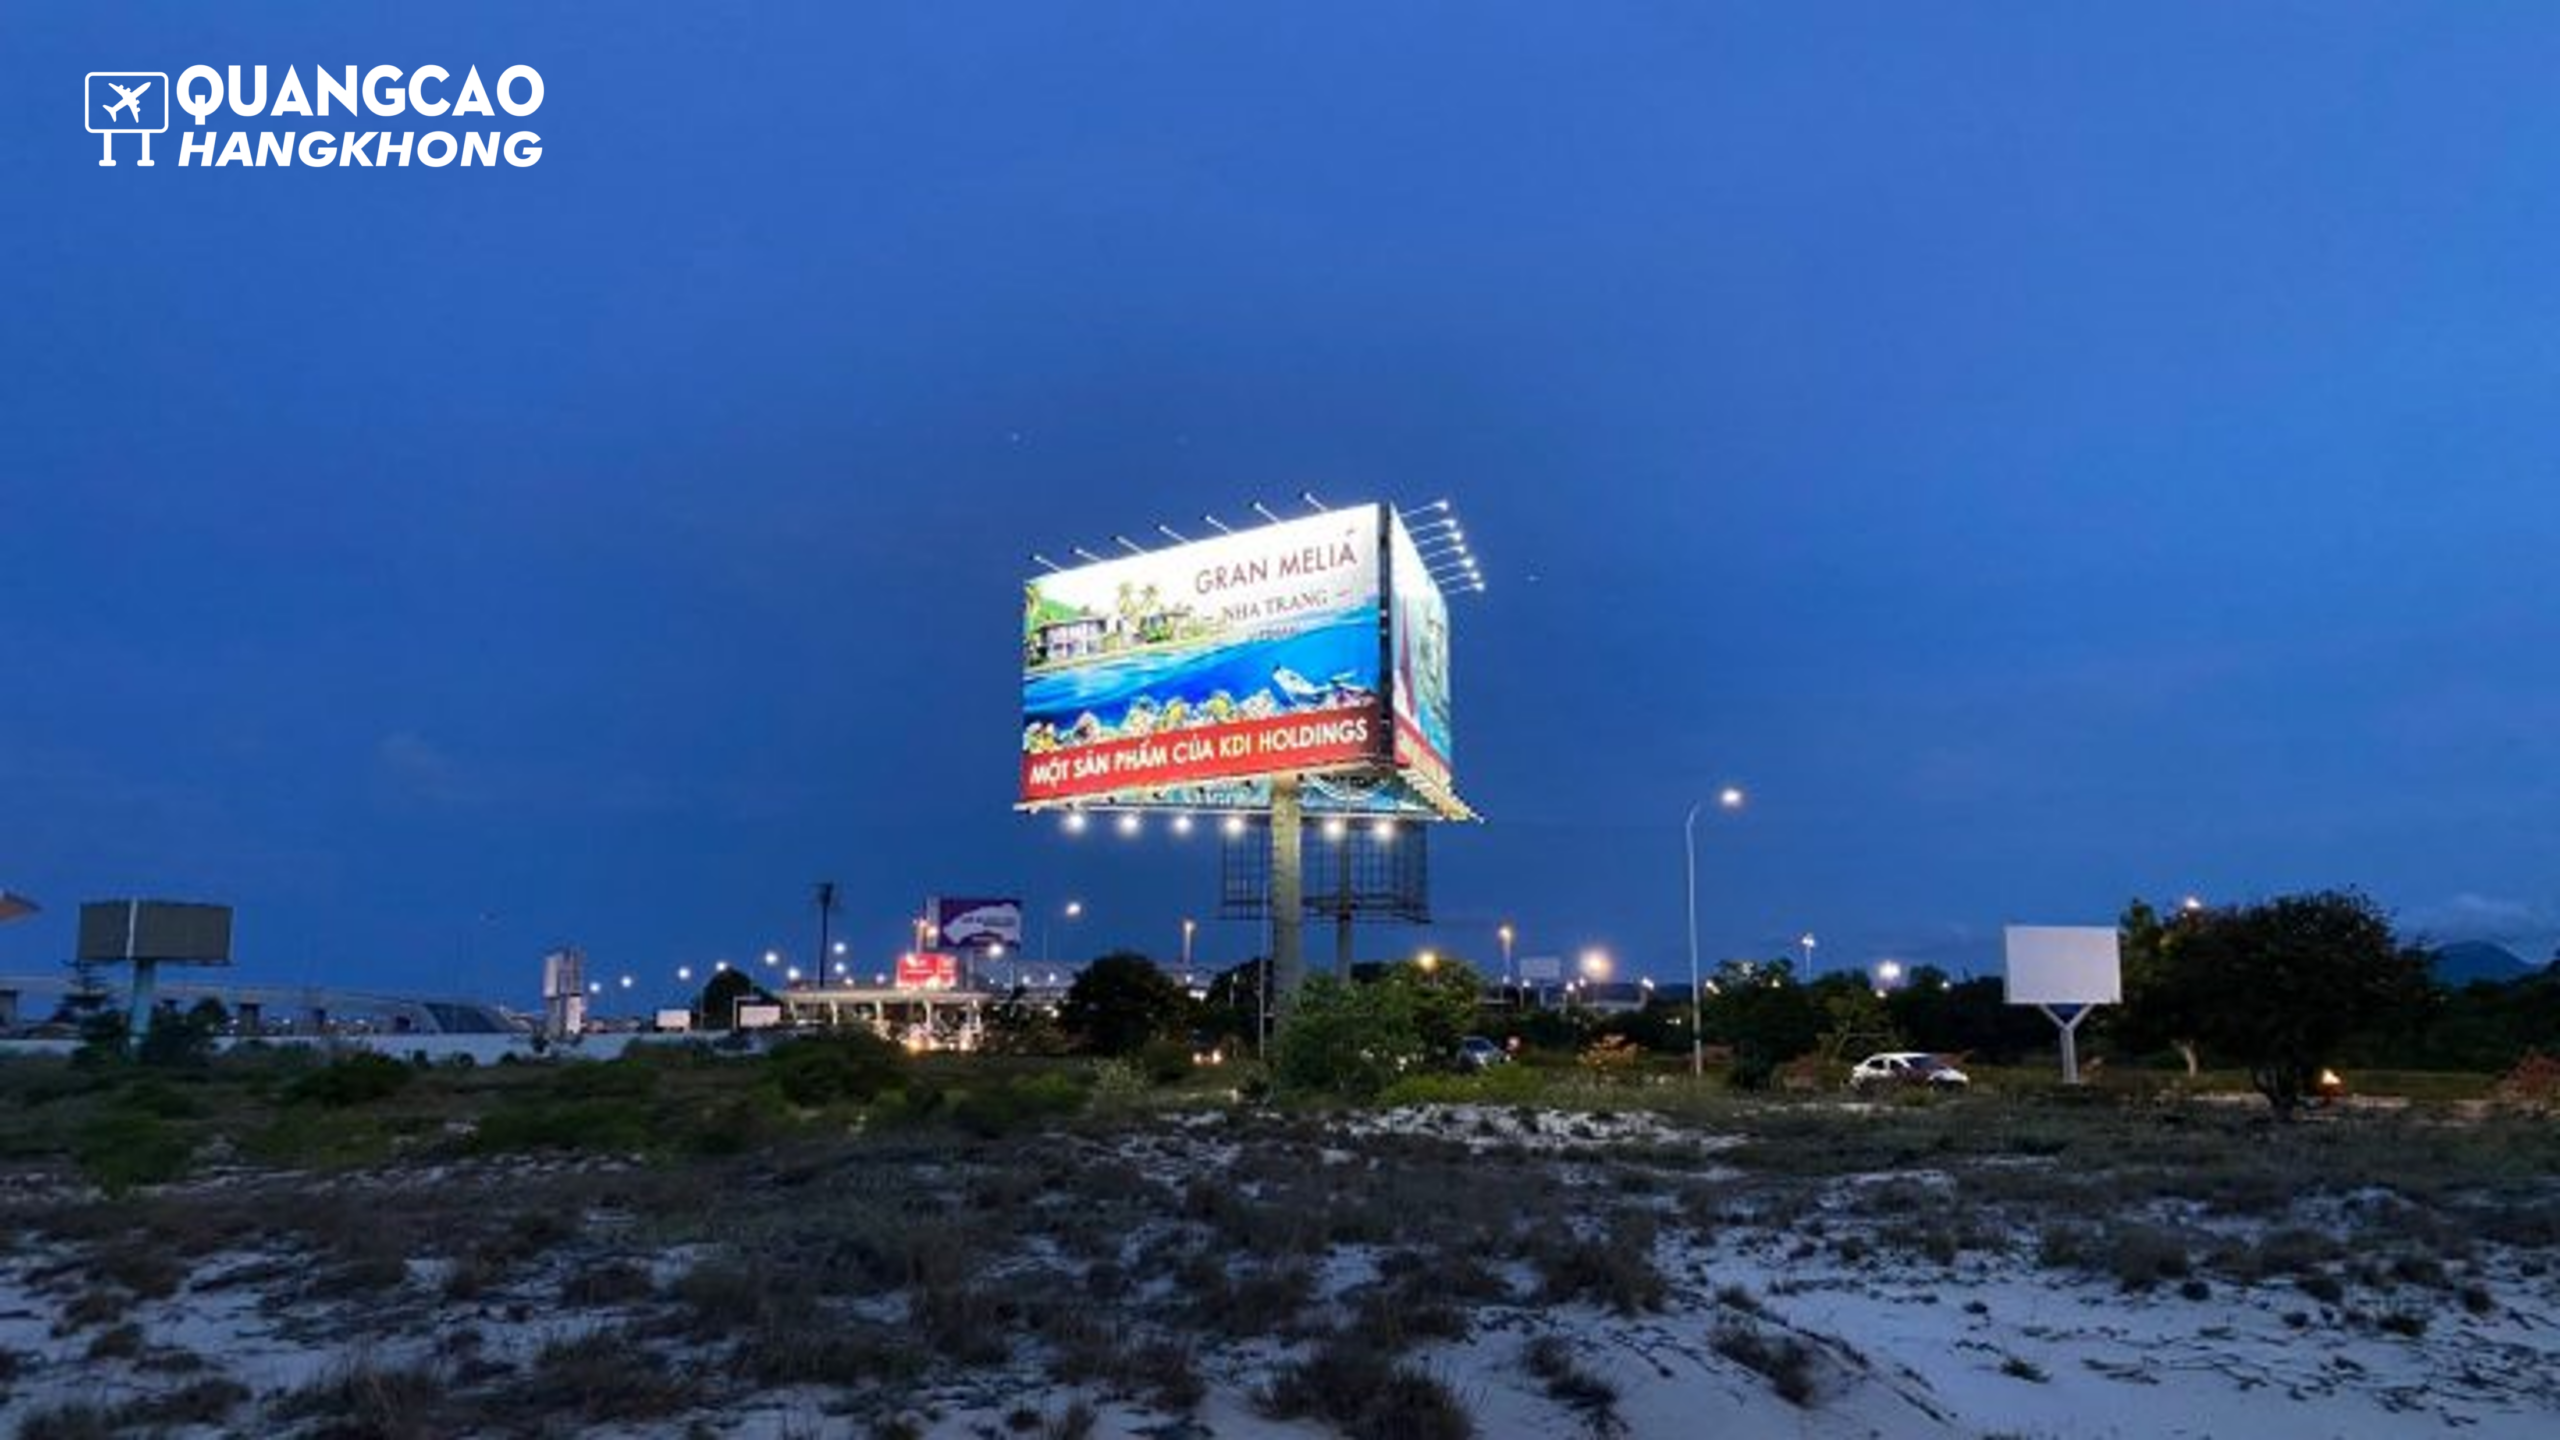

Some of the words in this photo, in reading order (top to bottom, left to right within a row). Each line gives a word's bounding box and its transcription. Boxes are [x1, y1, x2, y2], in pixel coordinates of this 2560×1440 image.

[1196, 559, 1268, 594] GRAN
[1222, 602, 1261, 620] NHA
[1263, 589, 1328, 615] TRANG
[1219, 733, 1251, 758] KDI
[1259, 716, 1369, 753] HOLDINGS
